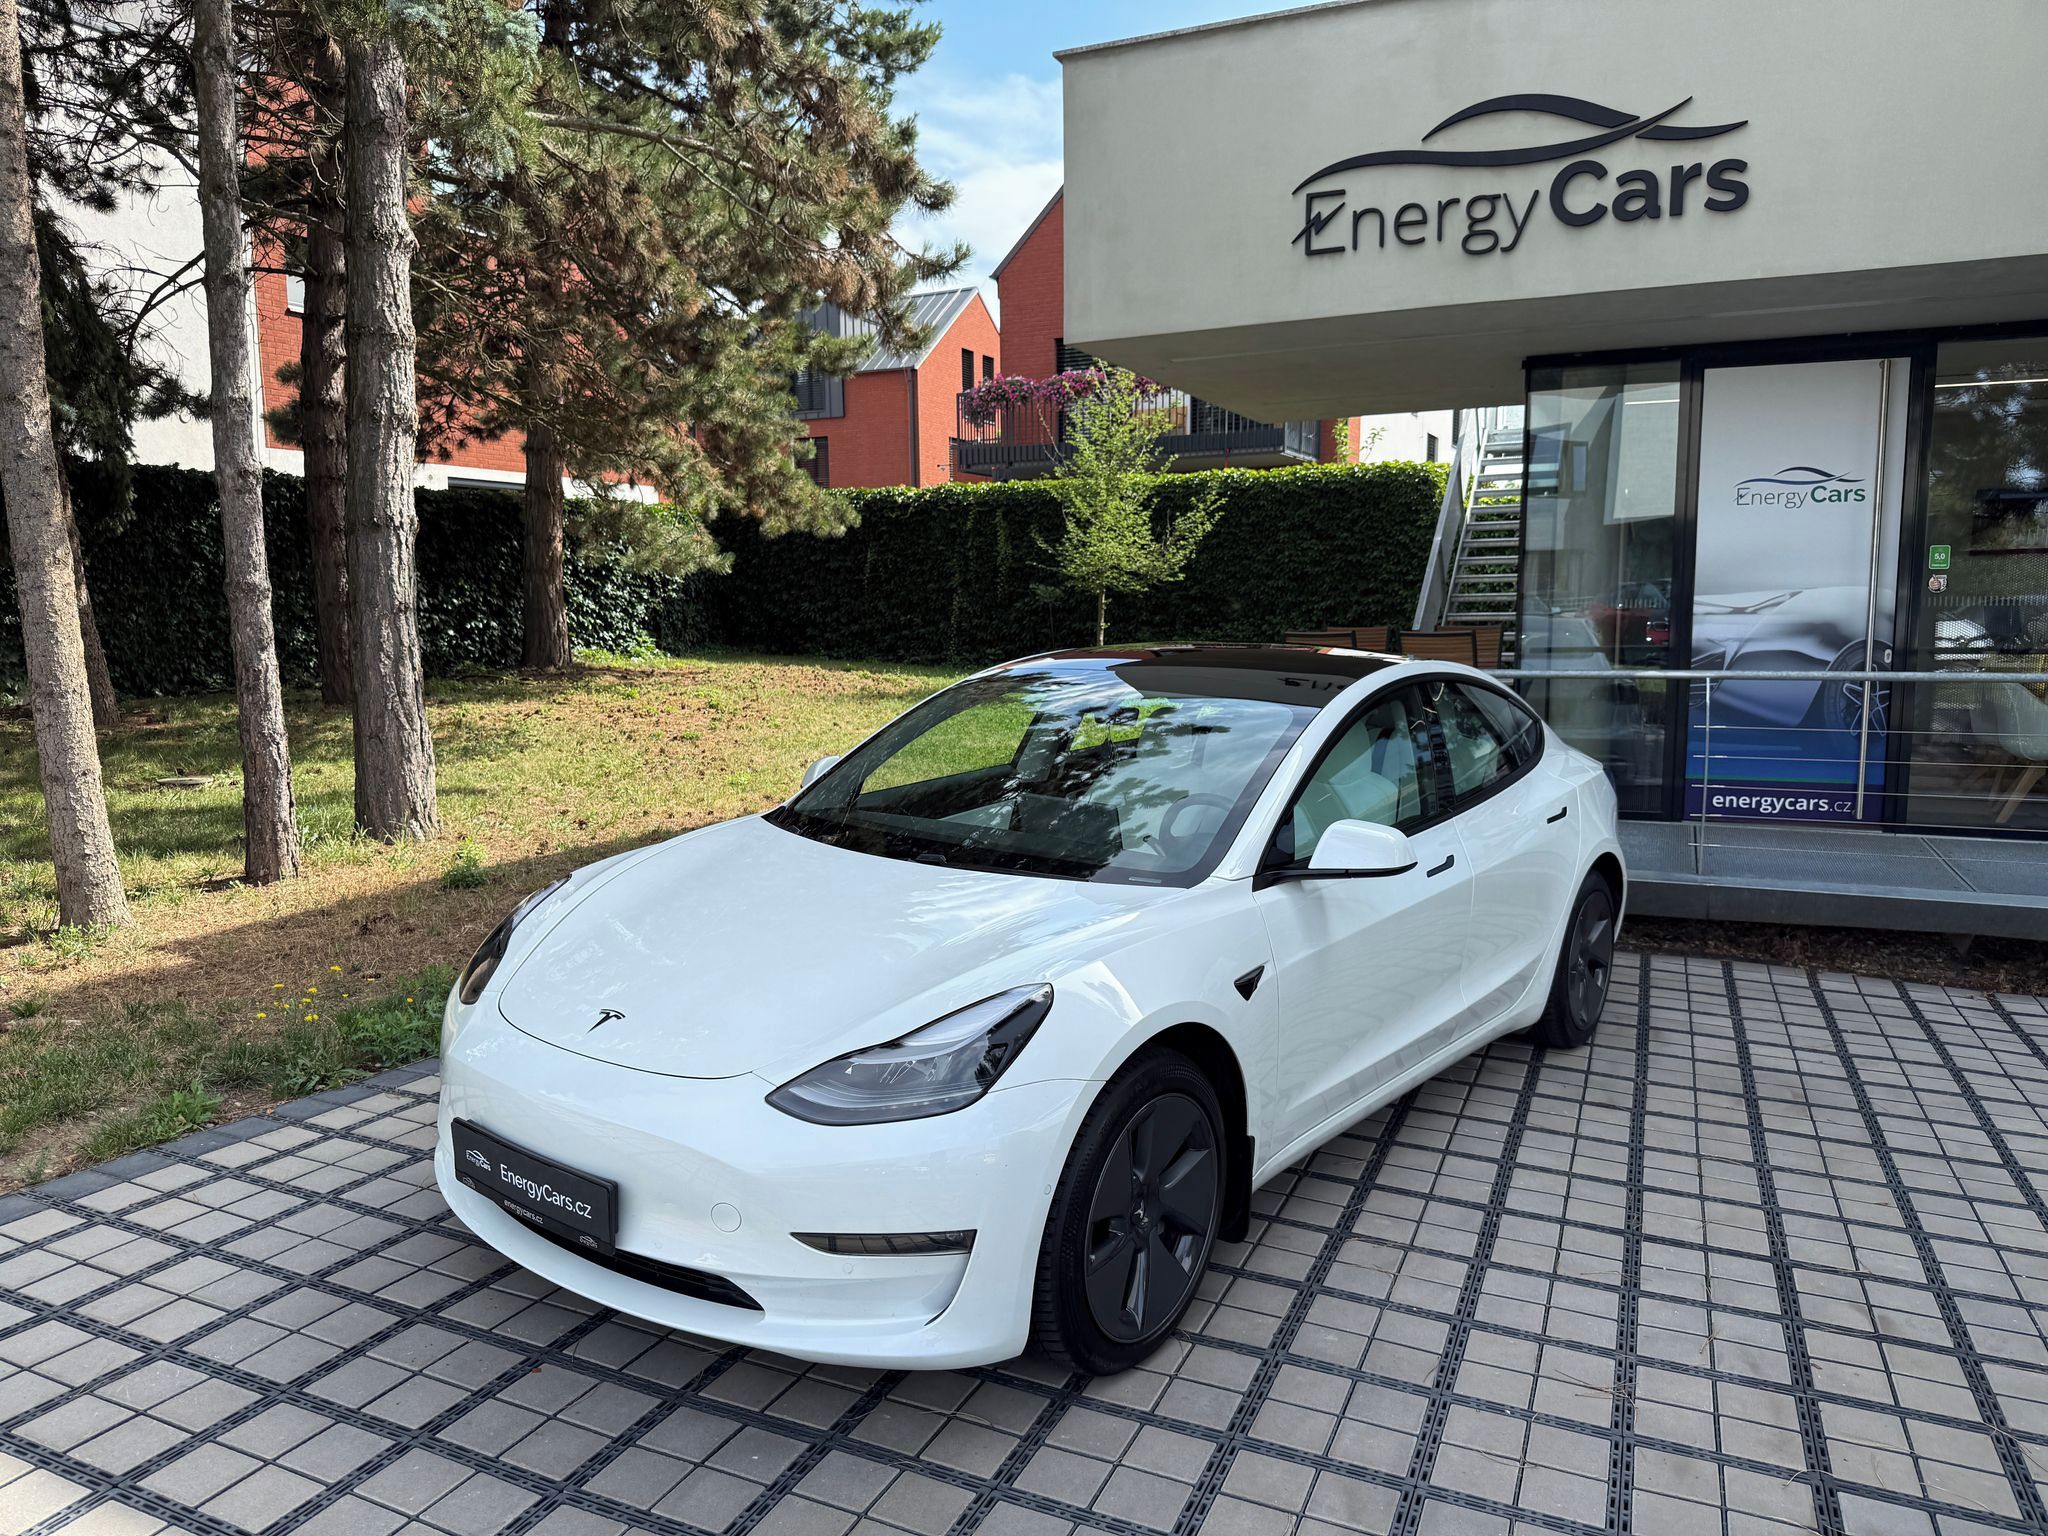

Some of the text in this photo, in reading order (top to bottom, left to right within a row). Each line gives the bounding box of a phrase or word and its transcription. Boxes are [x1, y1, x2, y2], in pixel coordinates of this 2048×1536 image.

[1292, 158, 1750, 256] EnergyCars
[1734, 485, 1866, 509] EnergyCars
[1712, 794, 1852, 814] energycars.cz
[500, 1163, 592, 1219] EnergyCars.cz
[503, 1199, 544, 1224] energycars.cz
